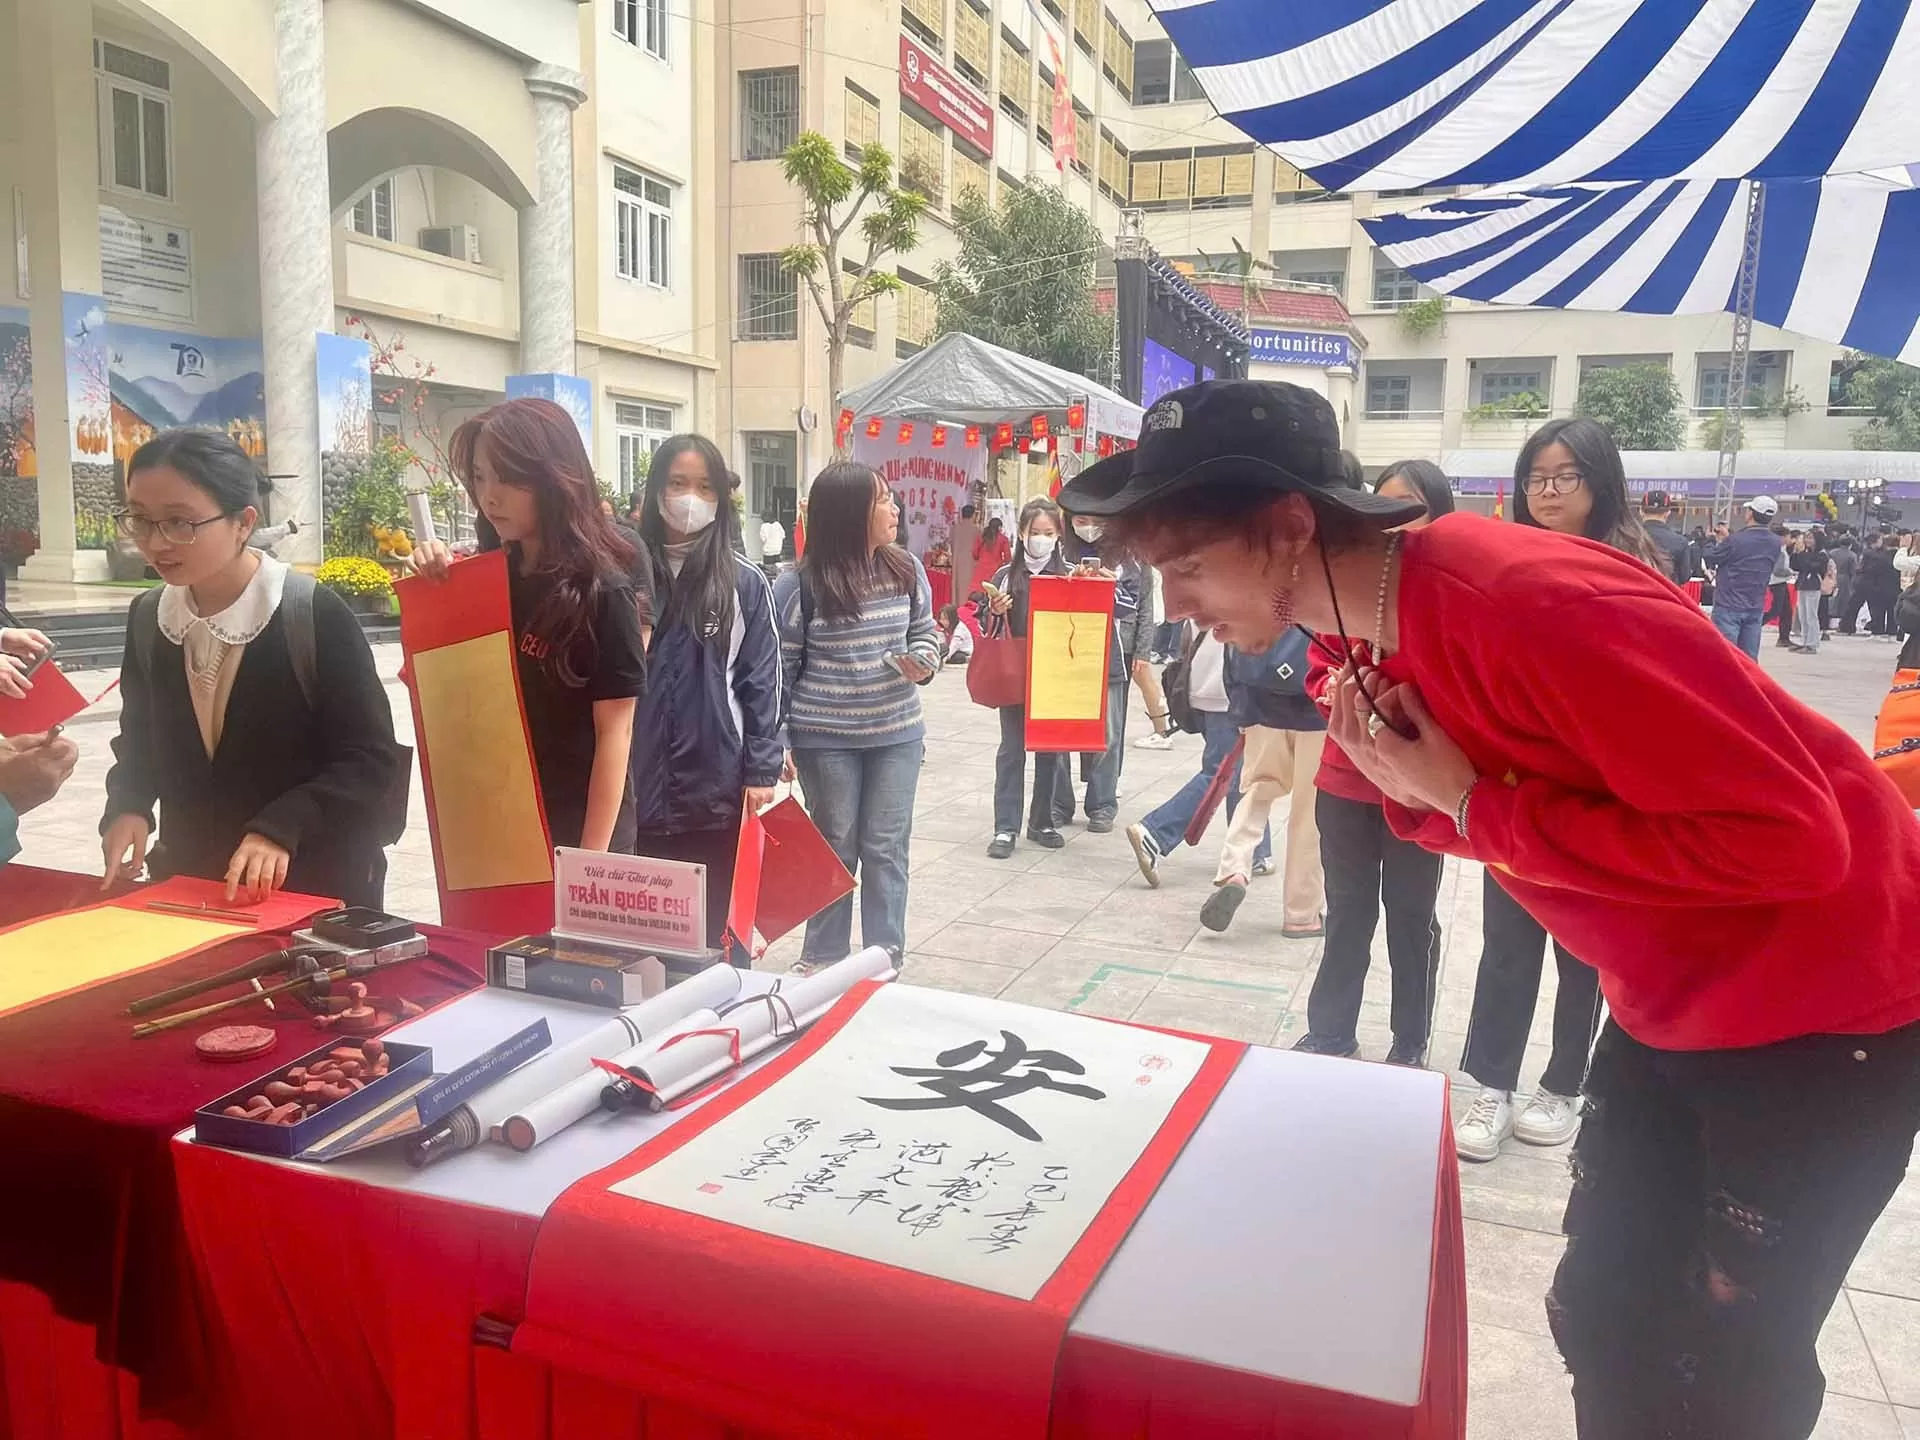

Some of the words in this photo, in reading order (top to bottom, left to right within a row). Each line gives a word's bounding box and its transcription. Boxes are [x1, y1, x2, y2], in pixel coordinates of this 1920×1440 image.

[1248, 334, 1342, 355] ortunities
[615, 888, 657, 913] QUỐC
[858, 1029, 1107, 1142] 安
